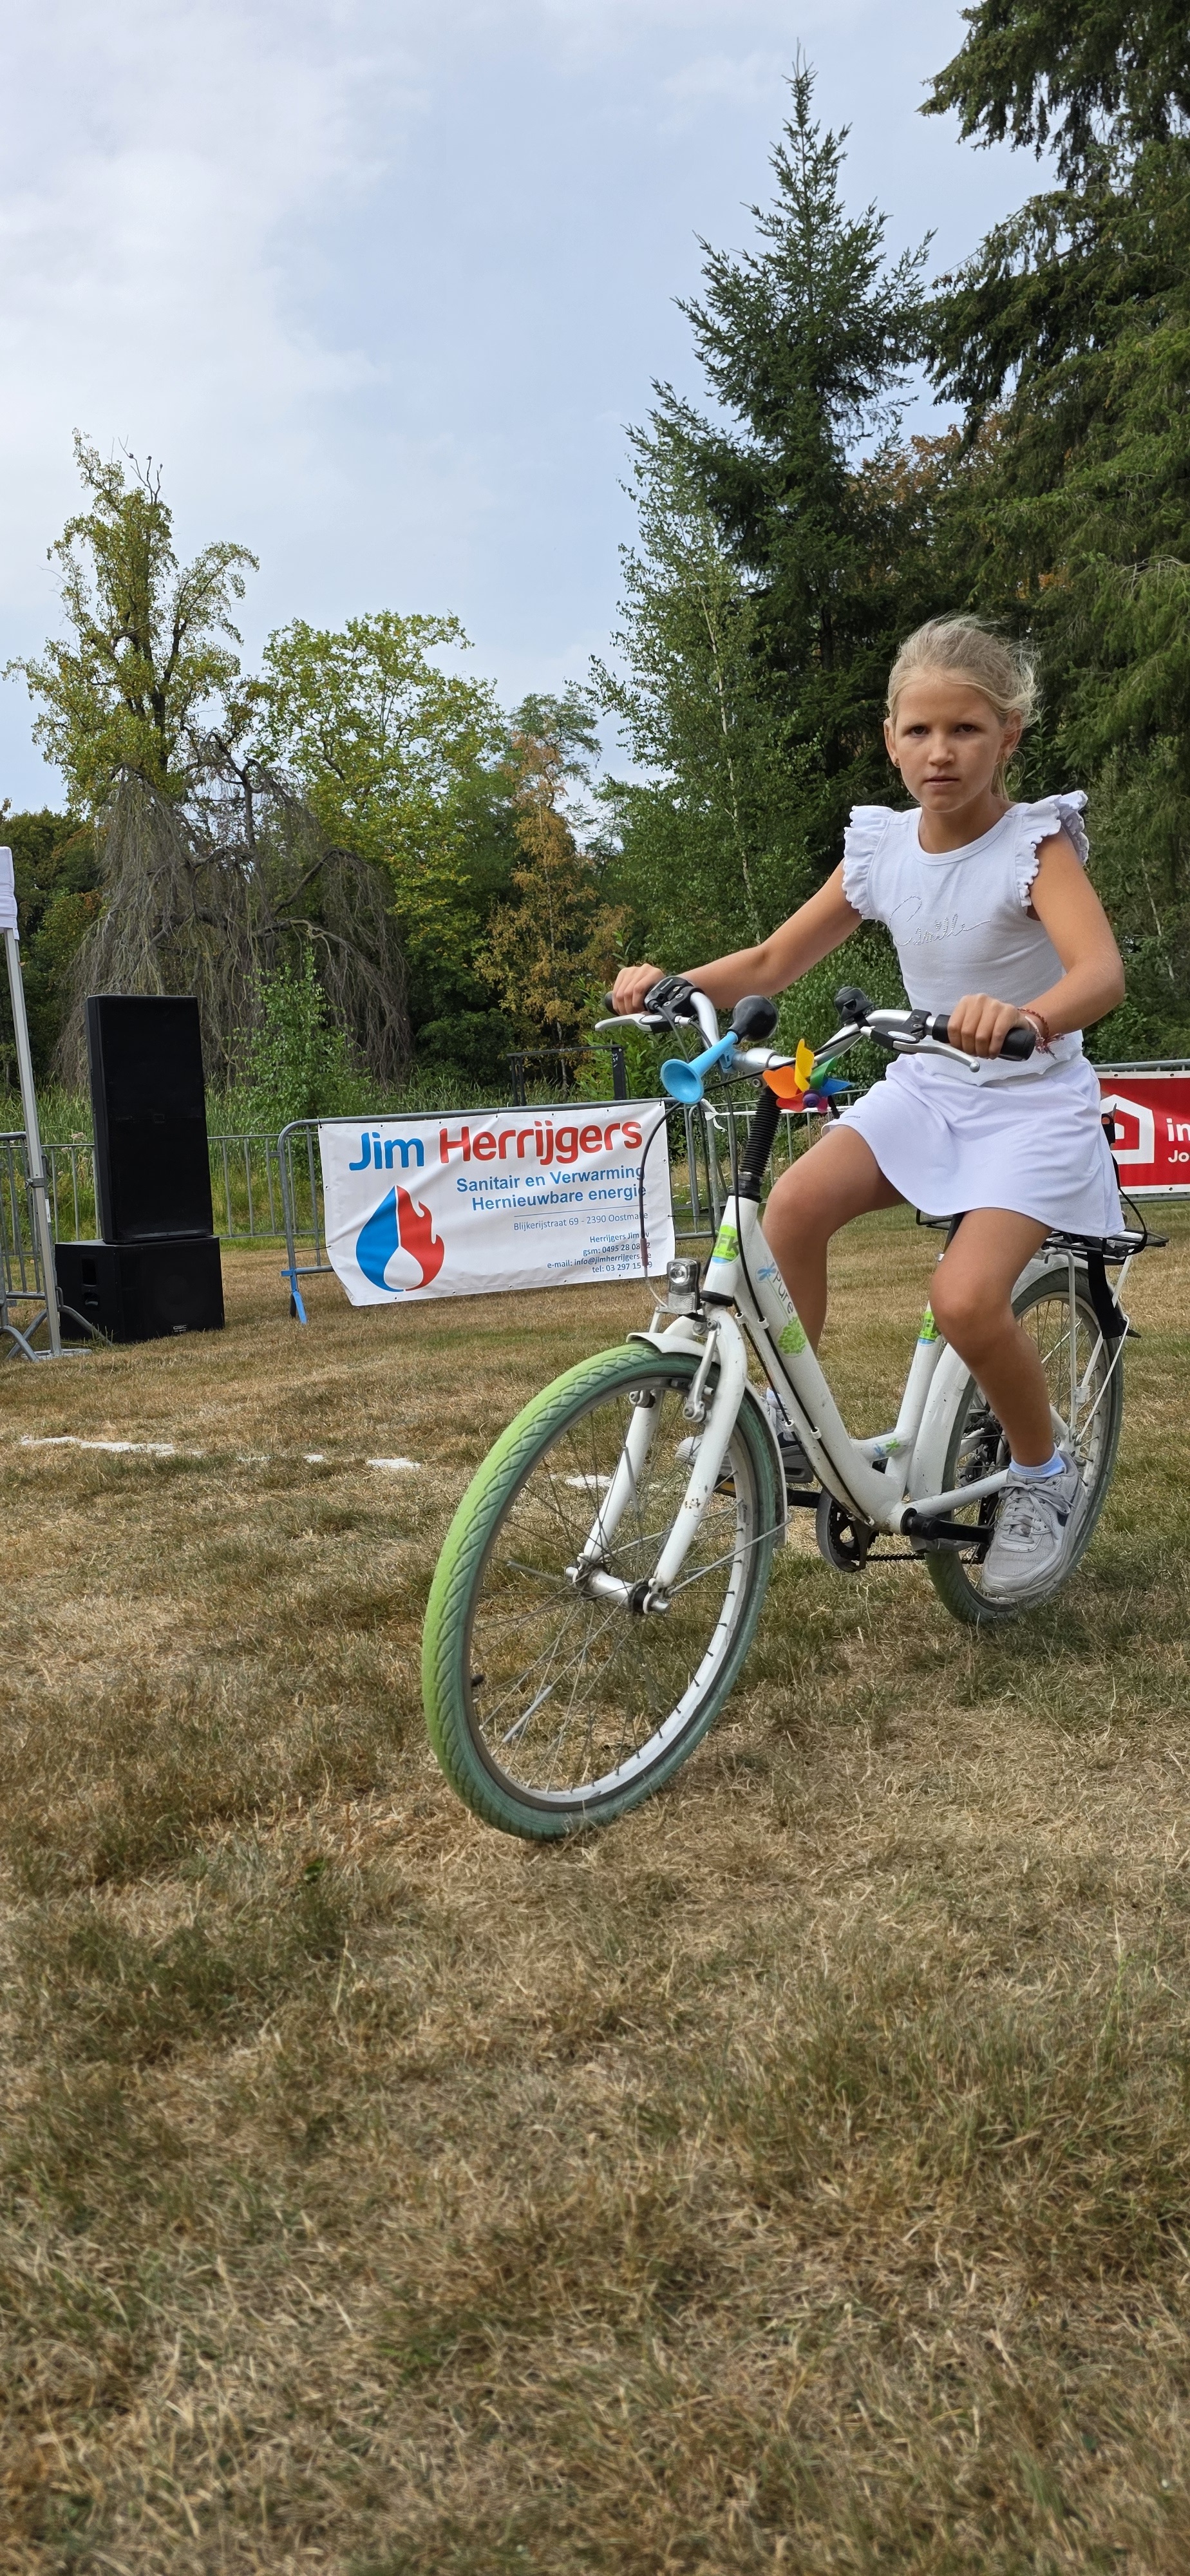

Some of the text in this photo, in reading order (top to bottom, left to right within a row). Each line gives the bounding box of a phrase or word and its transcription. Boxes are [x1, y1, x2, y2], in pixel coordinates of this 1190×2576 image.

[349, 1119, 643, 1171] Jim Herrijgers
[457, 1175, 520, 1193] Sanitair
[525, 1177, 546, 1187] en
[472, 1191, 583, 1211] Hernieuwbare
[514, 1219, 567, 1232] Blijkerijstraat
[569, 1217, 579, 1226] 69
[587, 1215, 606, 1224] 2390
[589, 1233, 627, 1244] Herrijgers
[583, 1248, 601, 1257] gsm:
[547, 1260, 572, 1269] e-mail:
[773, 1270, 794, 1314] pure
